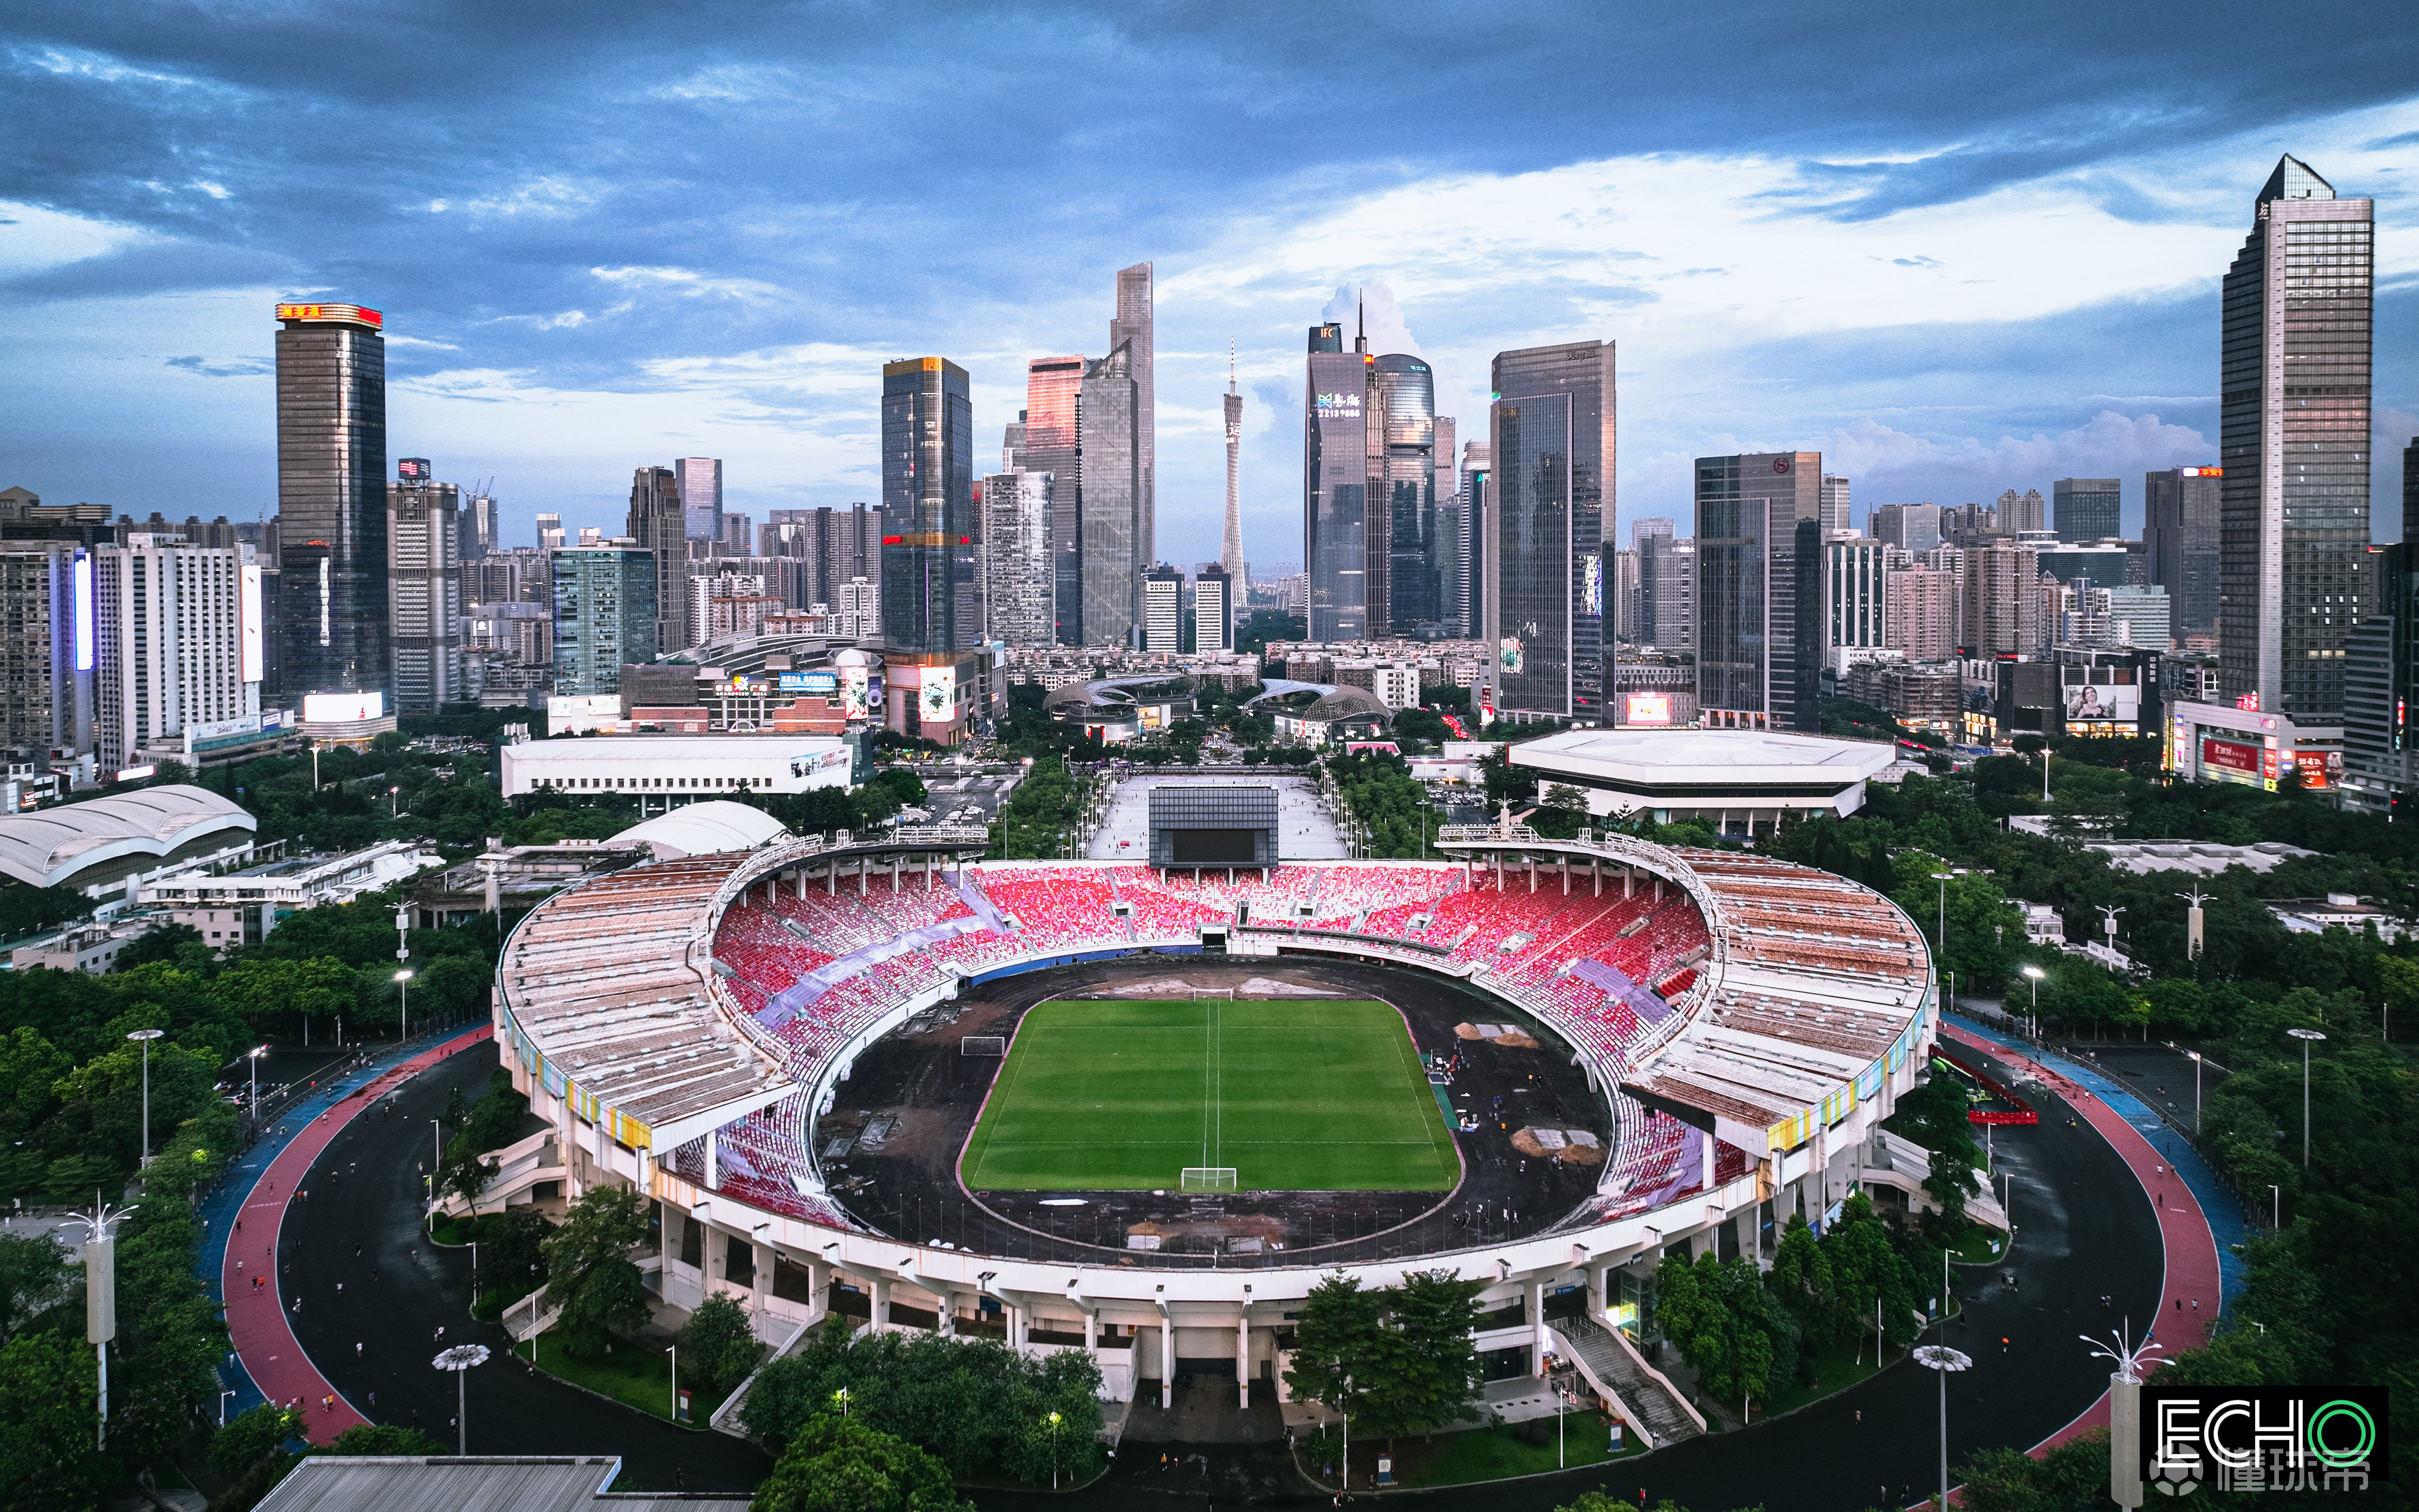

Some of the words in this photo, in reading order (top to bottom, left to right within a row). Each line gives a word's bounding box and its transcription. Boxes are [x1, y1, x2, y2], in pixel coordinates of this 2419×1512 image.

[1320, 328, 1333, 338] IFC
[1566, 349, 1596, 360] 天河城
